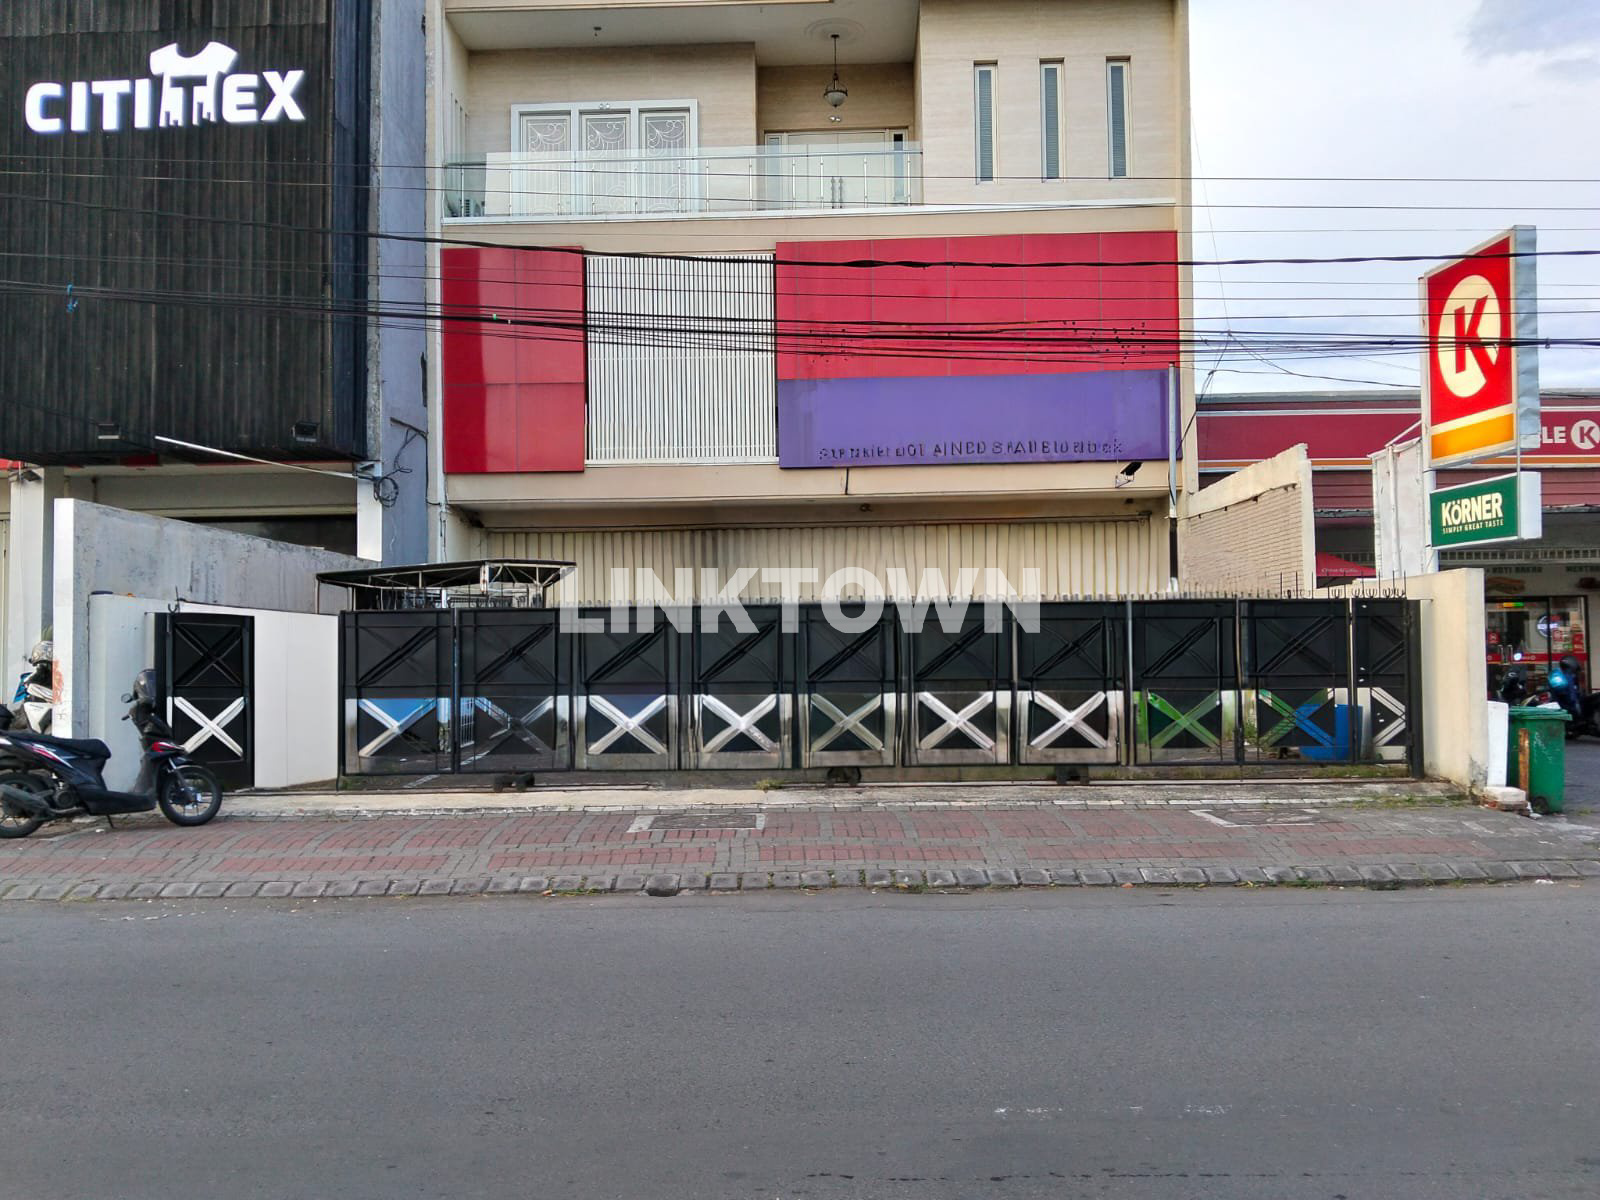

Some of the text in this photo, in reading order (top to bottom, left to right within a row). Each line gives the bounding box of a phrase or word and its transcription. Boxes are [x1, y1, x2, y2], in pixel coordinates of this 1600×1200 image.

[1441, 492, 1503, 526] KÖRNER
[1464, 521, 1483, 531] GREAT
[1485, 519, 1504, 529] TASTE
